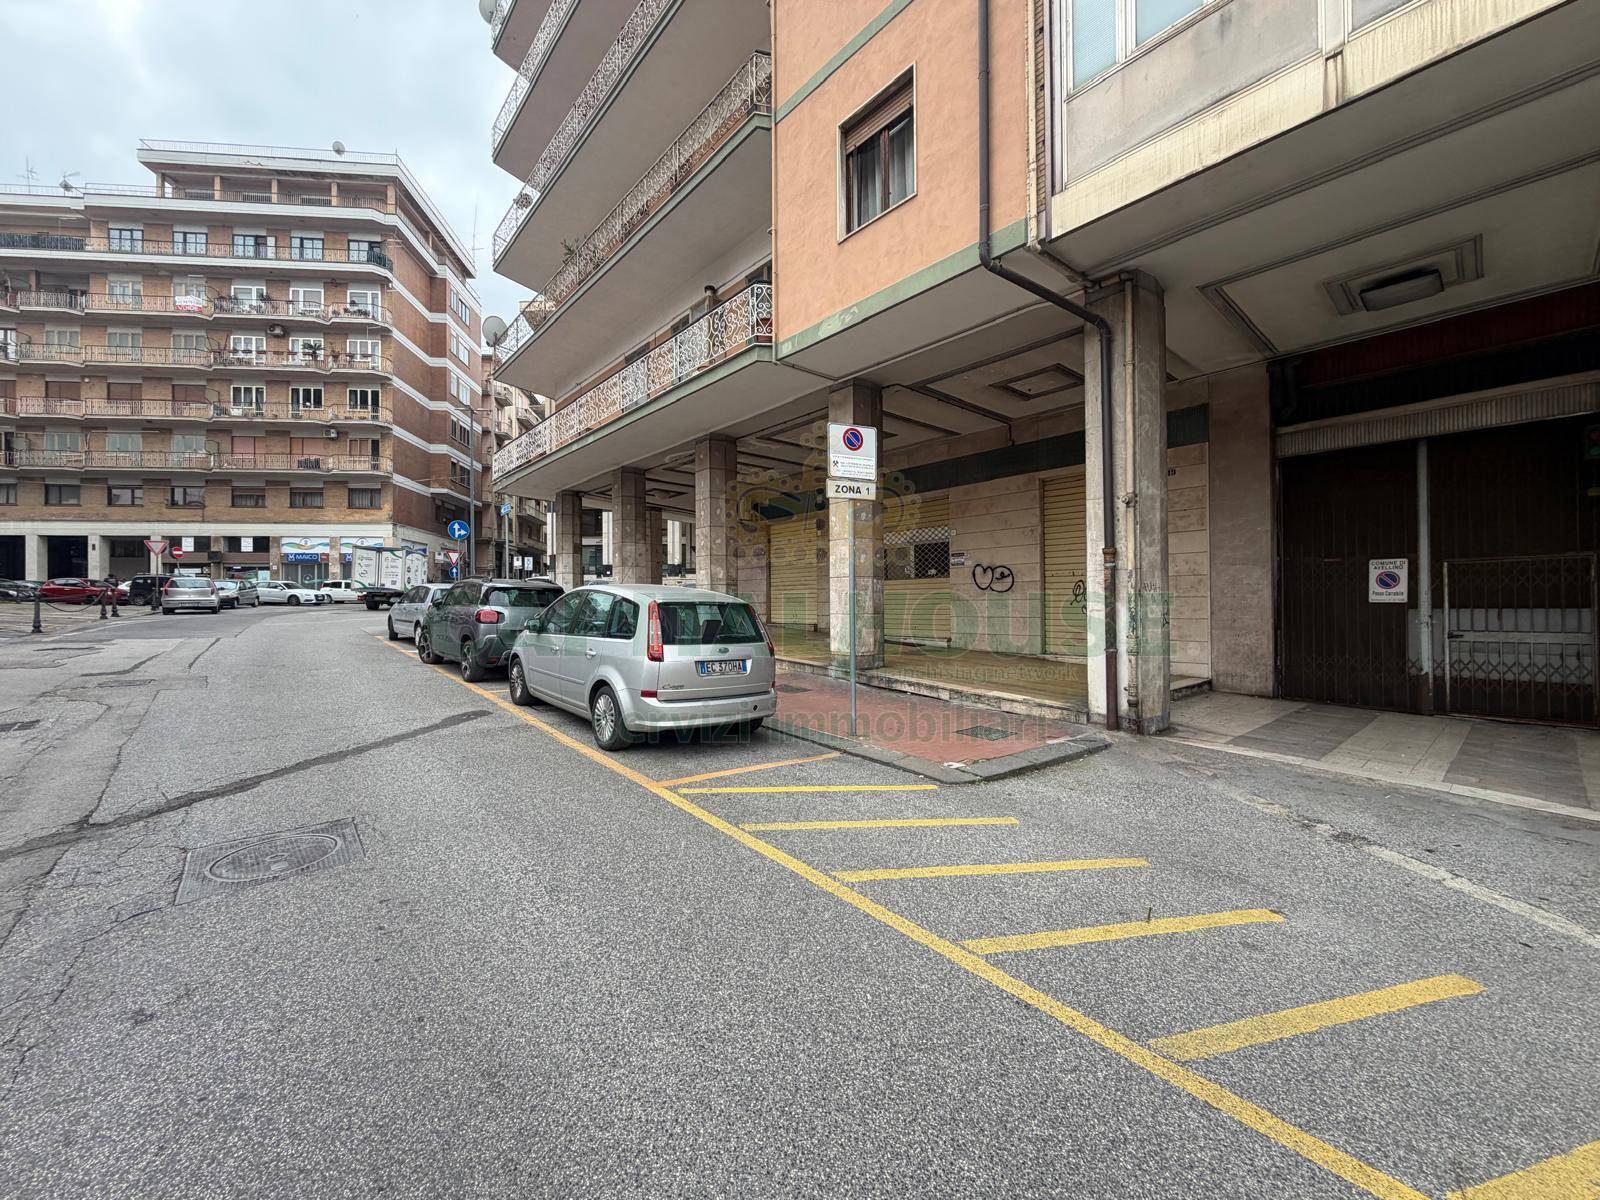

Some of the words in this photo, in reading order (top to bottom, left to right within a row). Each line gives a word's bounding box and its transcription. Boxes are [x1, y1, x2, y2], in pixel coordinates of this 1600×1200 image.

[834, 484, 862, 495] ZONA
[865, 487, 871, 496] 1
[706, 661, 716, 673] EC
[718, 660, 743, 673] 370HA
